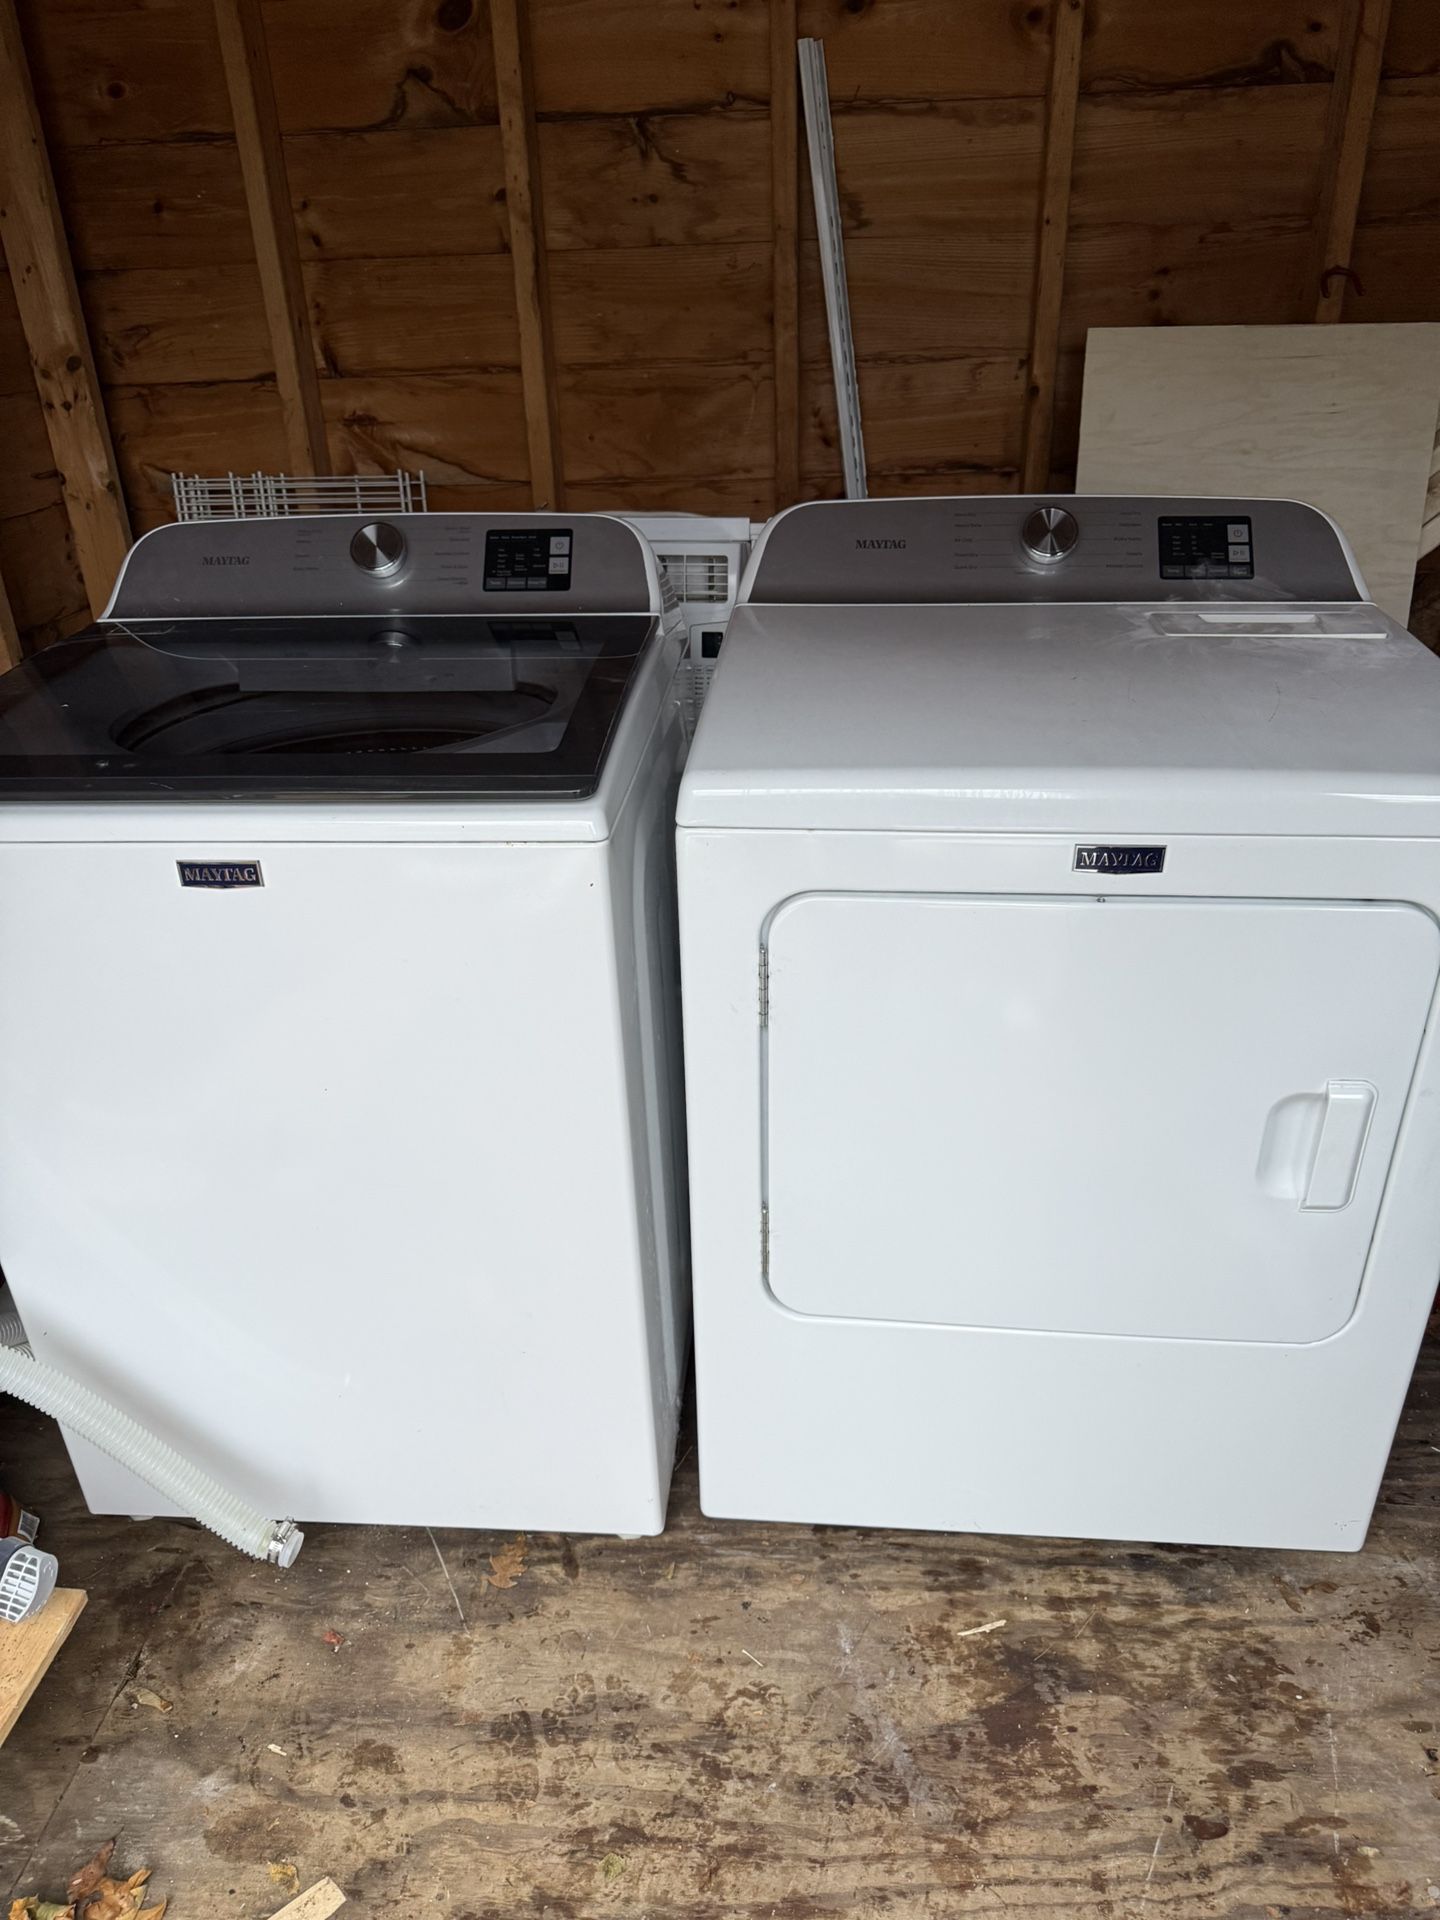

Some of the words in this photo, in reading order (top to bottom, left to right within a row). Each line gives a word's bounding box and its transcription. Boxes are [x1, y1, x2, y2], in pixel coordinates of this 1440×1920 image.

[855, 539, 906, 550] MAYTAG
[202, 556, 250, 566] MAYTAG
[1080, 852, 1159, 867] MAYTAG
[183, 867, 257, 882] MAYTAG
